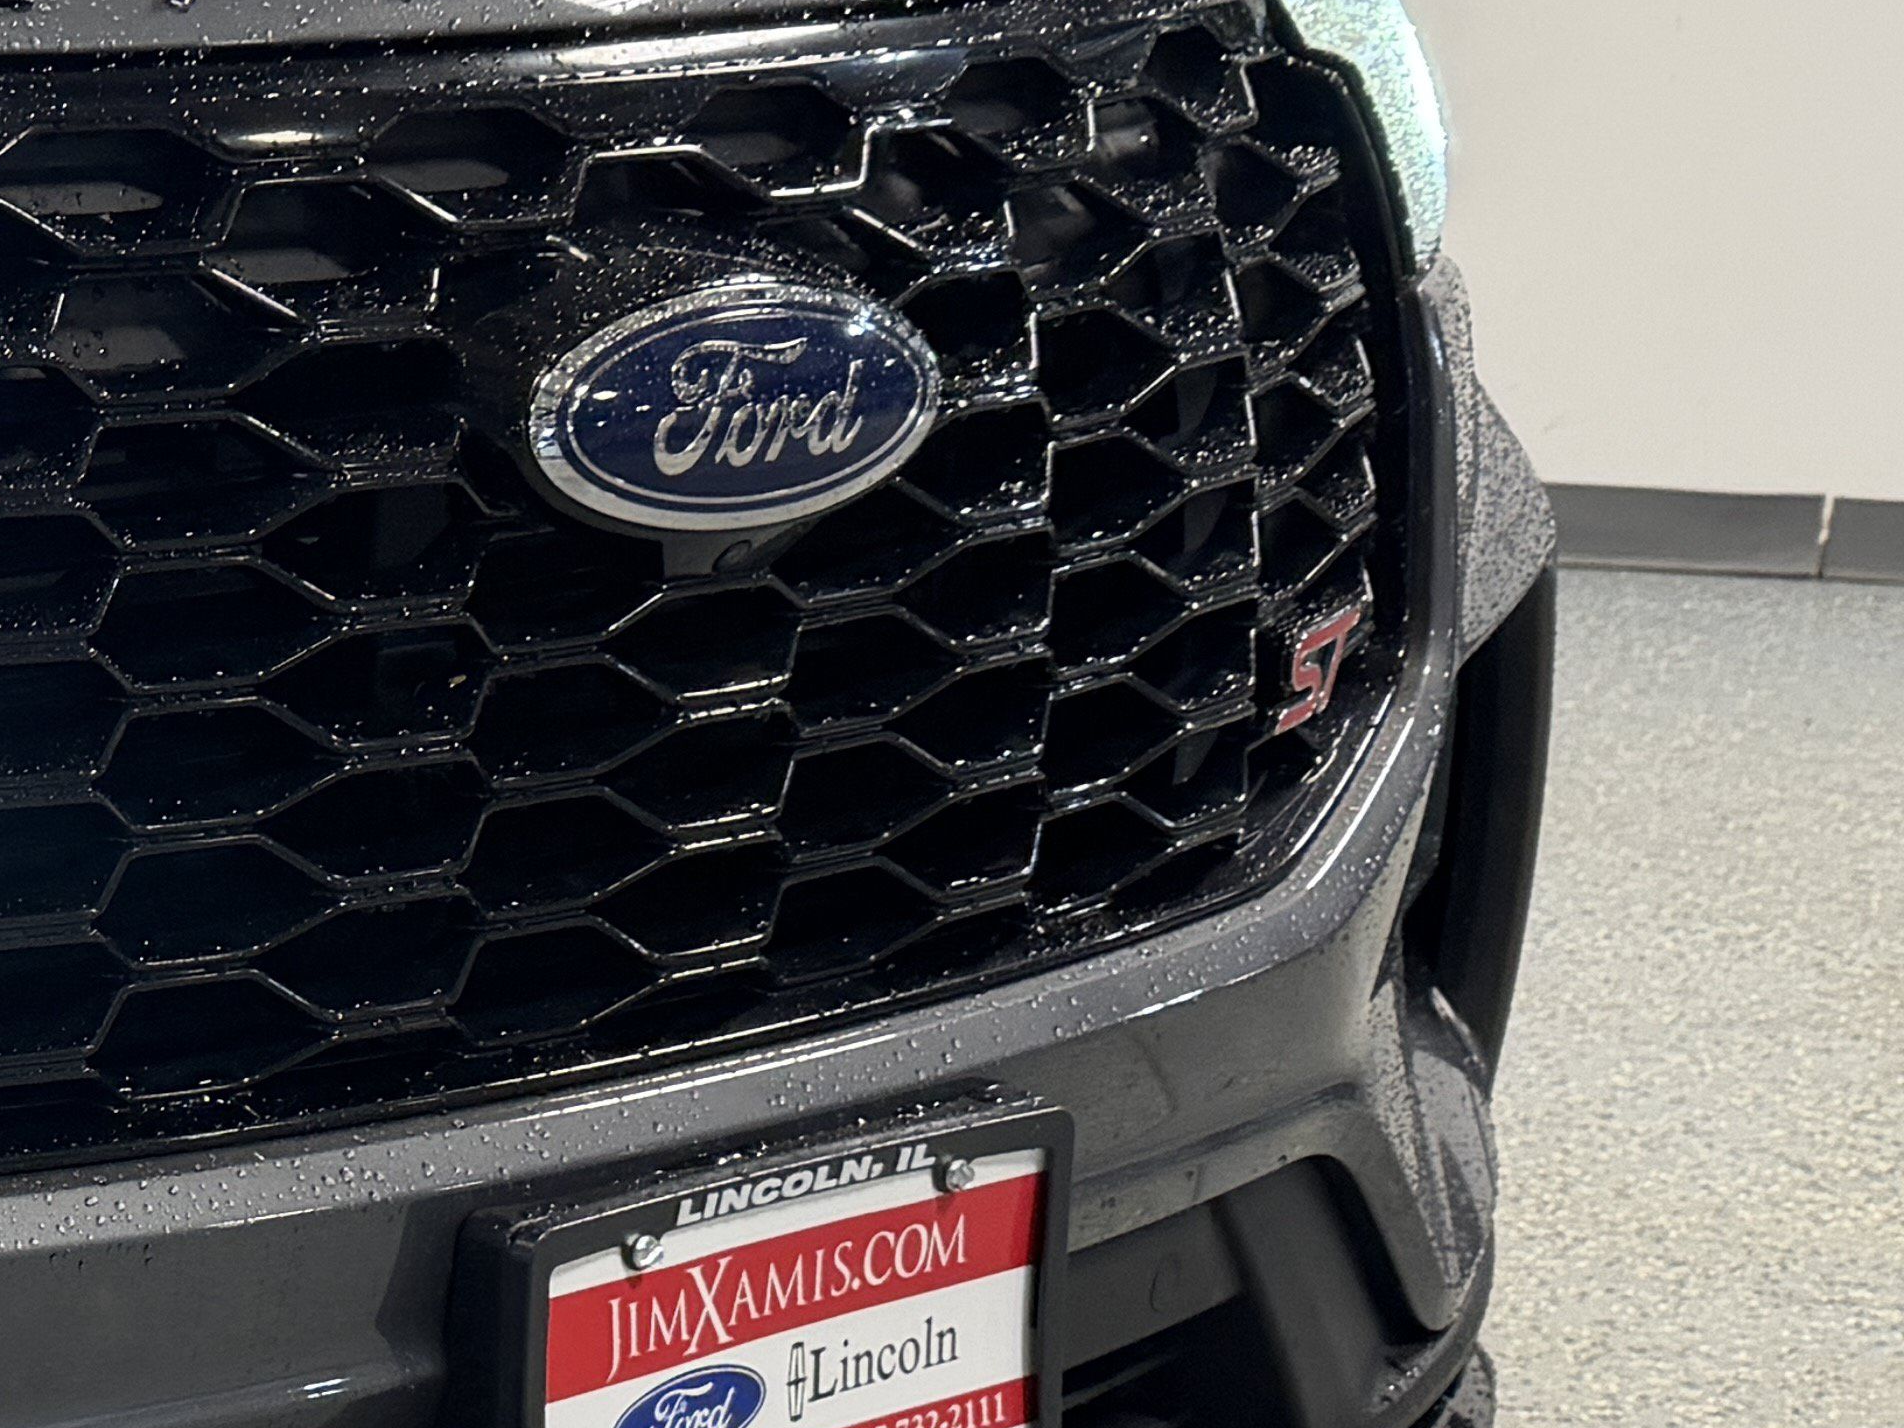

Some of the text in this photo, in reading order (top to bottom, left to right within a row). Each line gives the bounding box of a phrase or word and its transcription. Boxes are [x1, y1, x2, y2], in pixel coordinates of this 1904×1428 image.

[653, 336, 864, 476] Ford
[1275, 605, 1361, 735] ST
[677, 1143, 936, 1226] LINCOLN, IL
[808, 1317, 959, 1403] Lincoln
